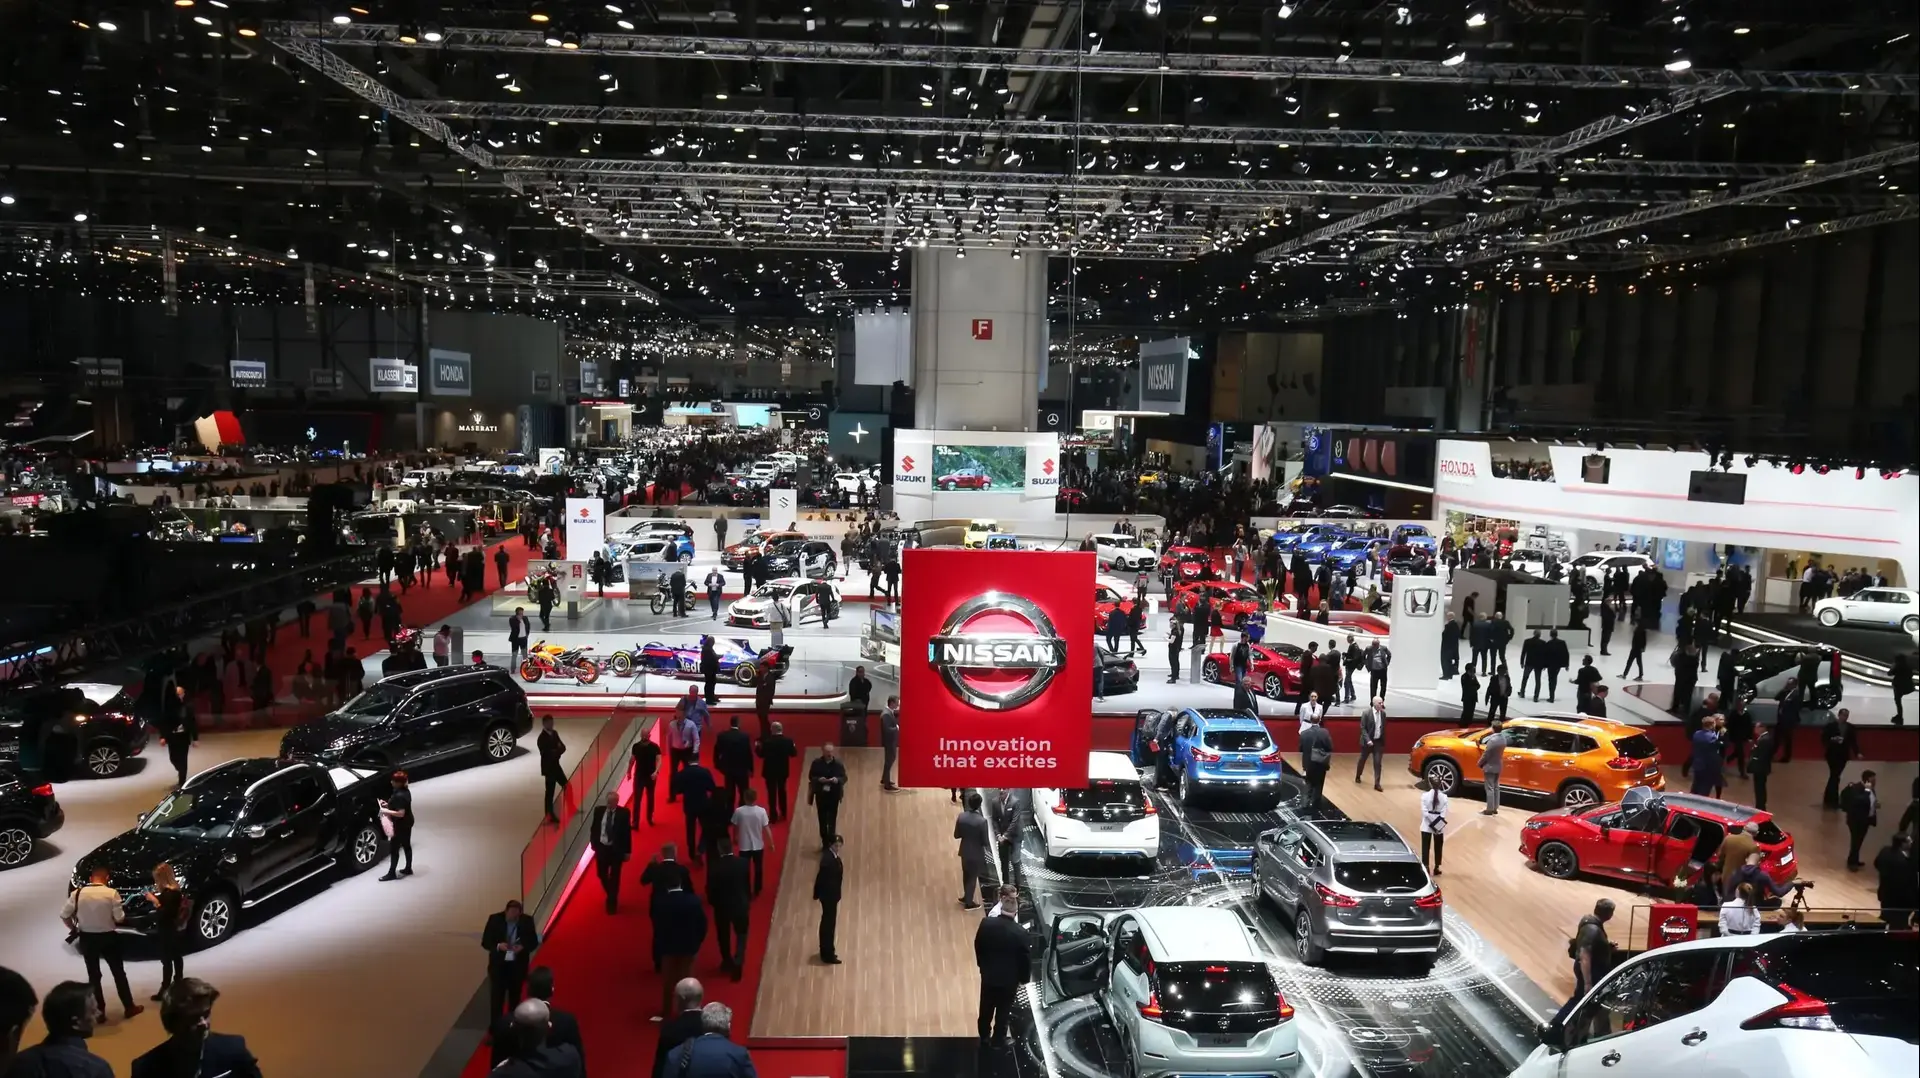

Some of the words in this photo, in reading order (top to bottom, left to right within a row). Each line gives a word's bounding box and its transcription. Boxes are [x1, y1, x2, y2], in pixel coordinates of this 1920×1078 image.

[978, 320, 988, 335] F
[377, 369, 400, 381] KLASSEN
[440, 364, 464, 382] HONDA
[1148, 364, 1175, 391] NISSAN
[1440, 459, 1476, 476] HONDA
[895, 474, 926, 483] SUZUKI
[943, 643, 1053, 662] NISSAN
[939, 737, 1051, 751] Innovation
[933, 754, 977, 768] that
[983, 754, 1057, 768] excites
